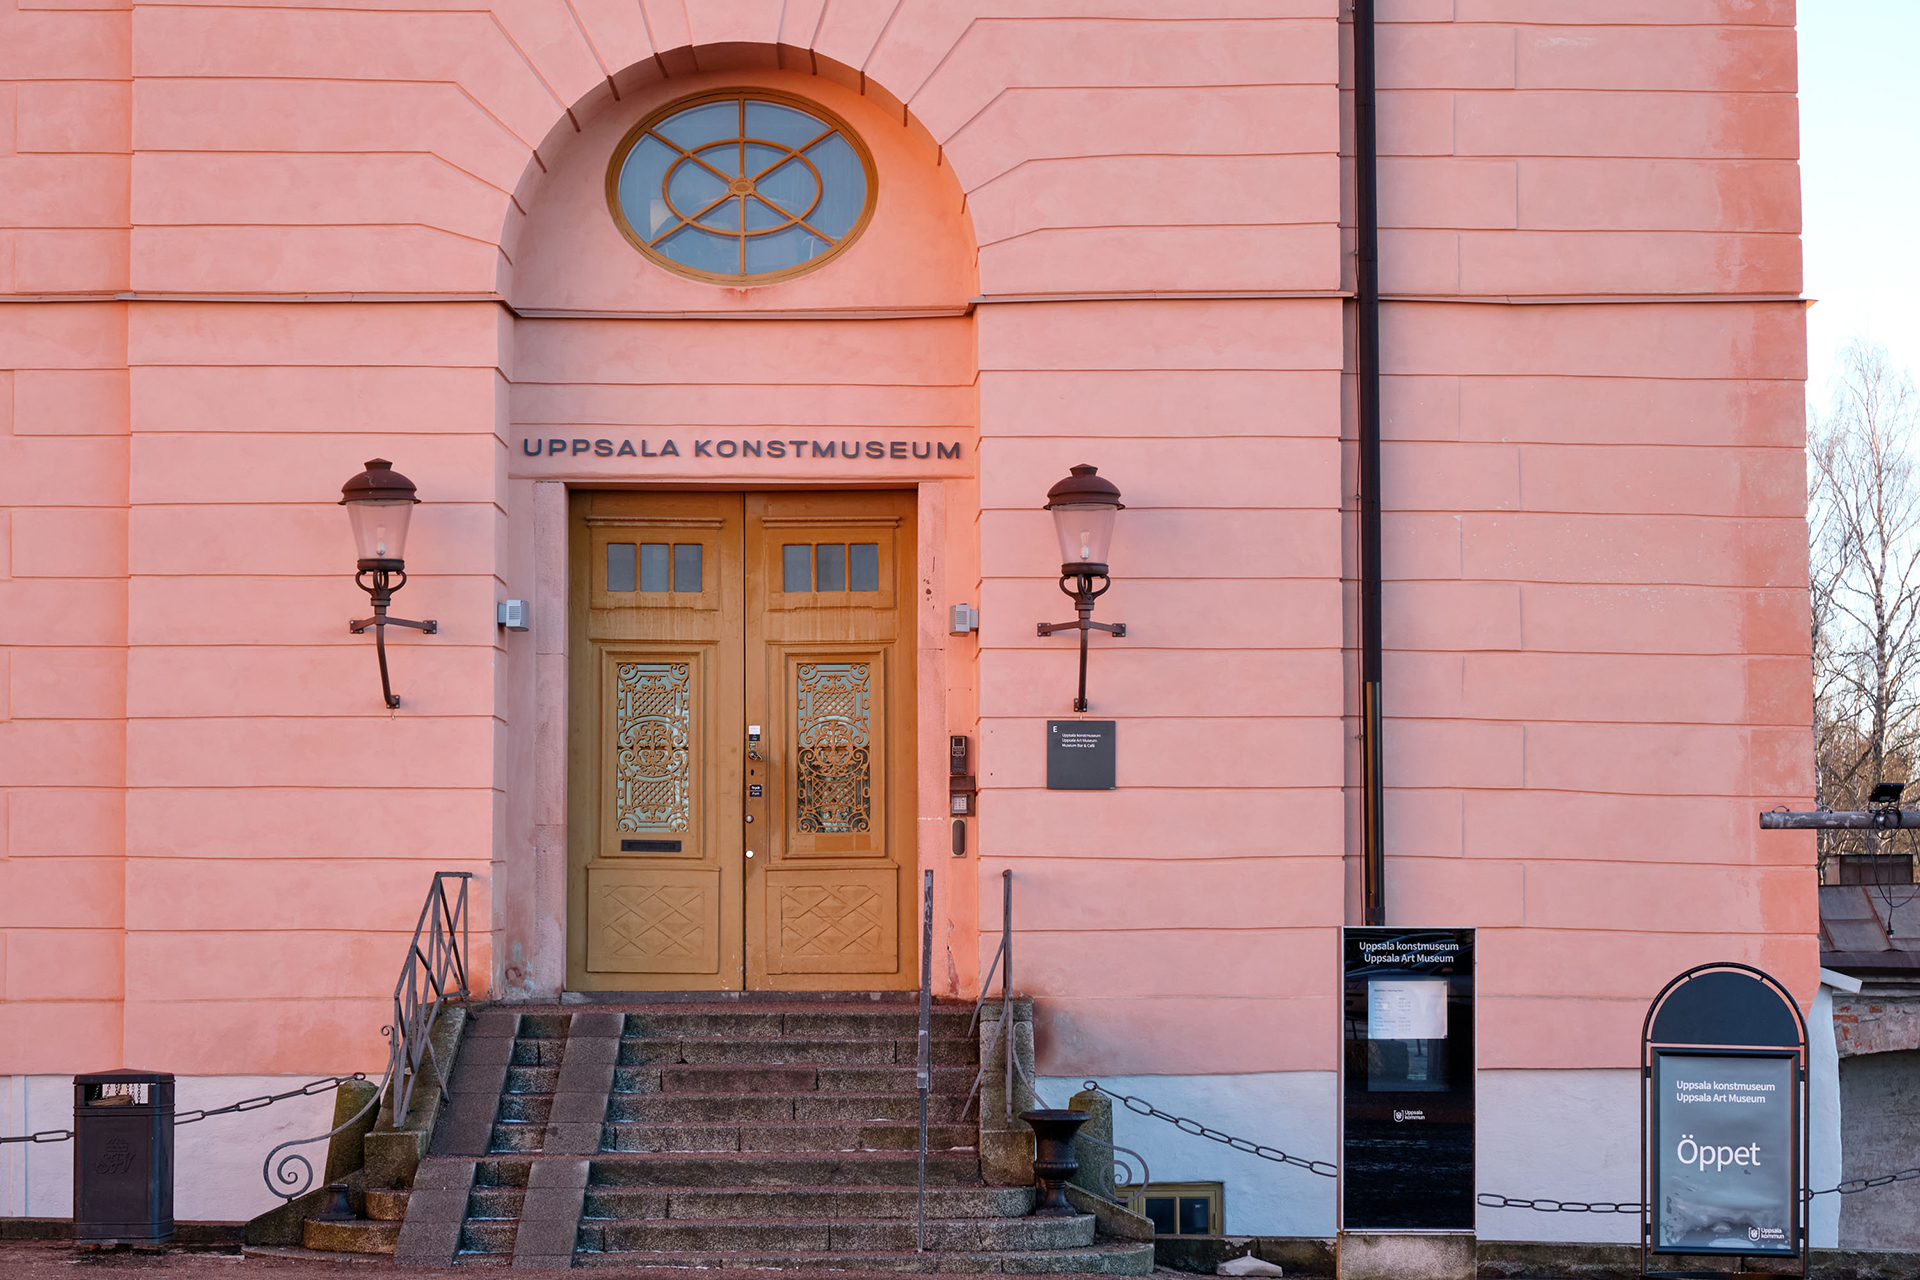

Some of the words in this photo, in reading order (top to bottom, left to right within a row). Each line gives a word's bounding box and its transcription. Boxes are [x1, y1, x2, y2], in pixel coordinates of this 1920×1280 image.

[523, 438, 680, 458] UPPSALA
[694, 439, 961, 460] KONSTMUSEUM
[1359, 941, 1395, 952] Uppsala
[1396, 941, 1459, 951] konstmuseum
[1364, 954, 1400, 964] Uppsala
[1400, 954, 1416, 963] Art
[1416, 954, 1454, 963] Museum
[1676, 1080, 1712, 1091] Uppsala
[1713, 1081, 1776, 1091] konstmuseum
[1676, 1093, 1712, 1103] Uppsala
[1712, 1093, 1727, 1103] Art
[1728, 1094, 1766, 1103] Museum
[1677, 1134, 1761, 1172] Öppet
[1760, 1227, 1782, 1235] Uppsala
